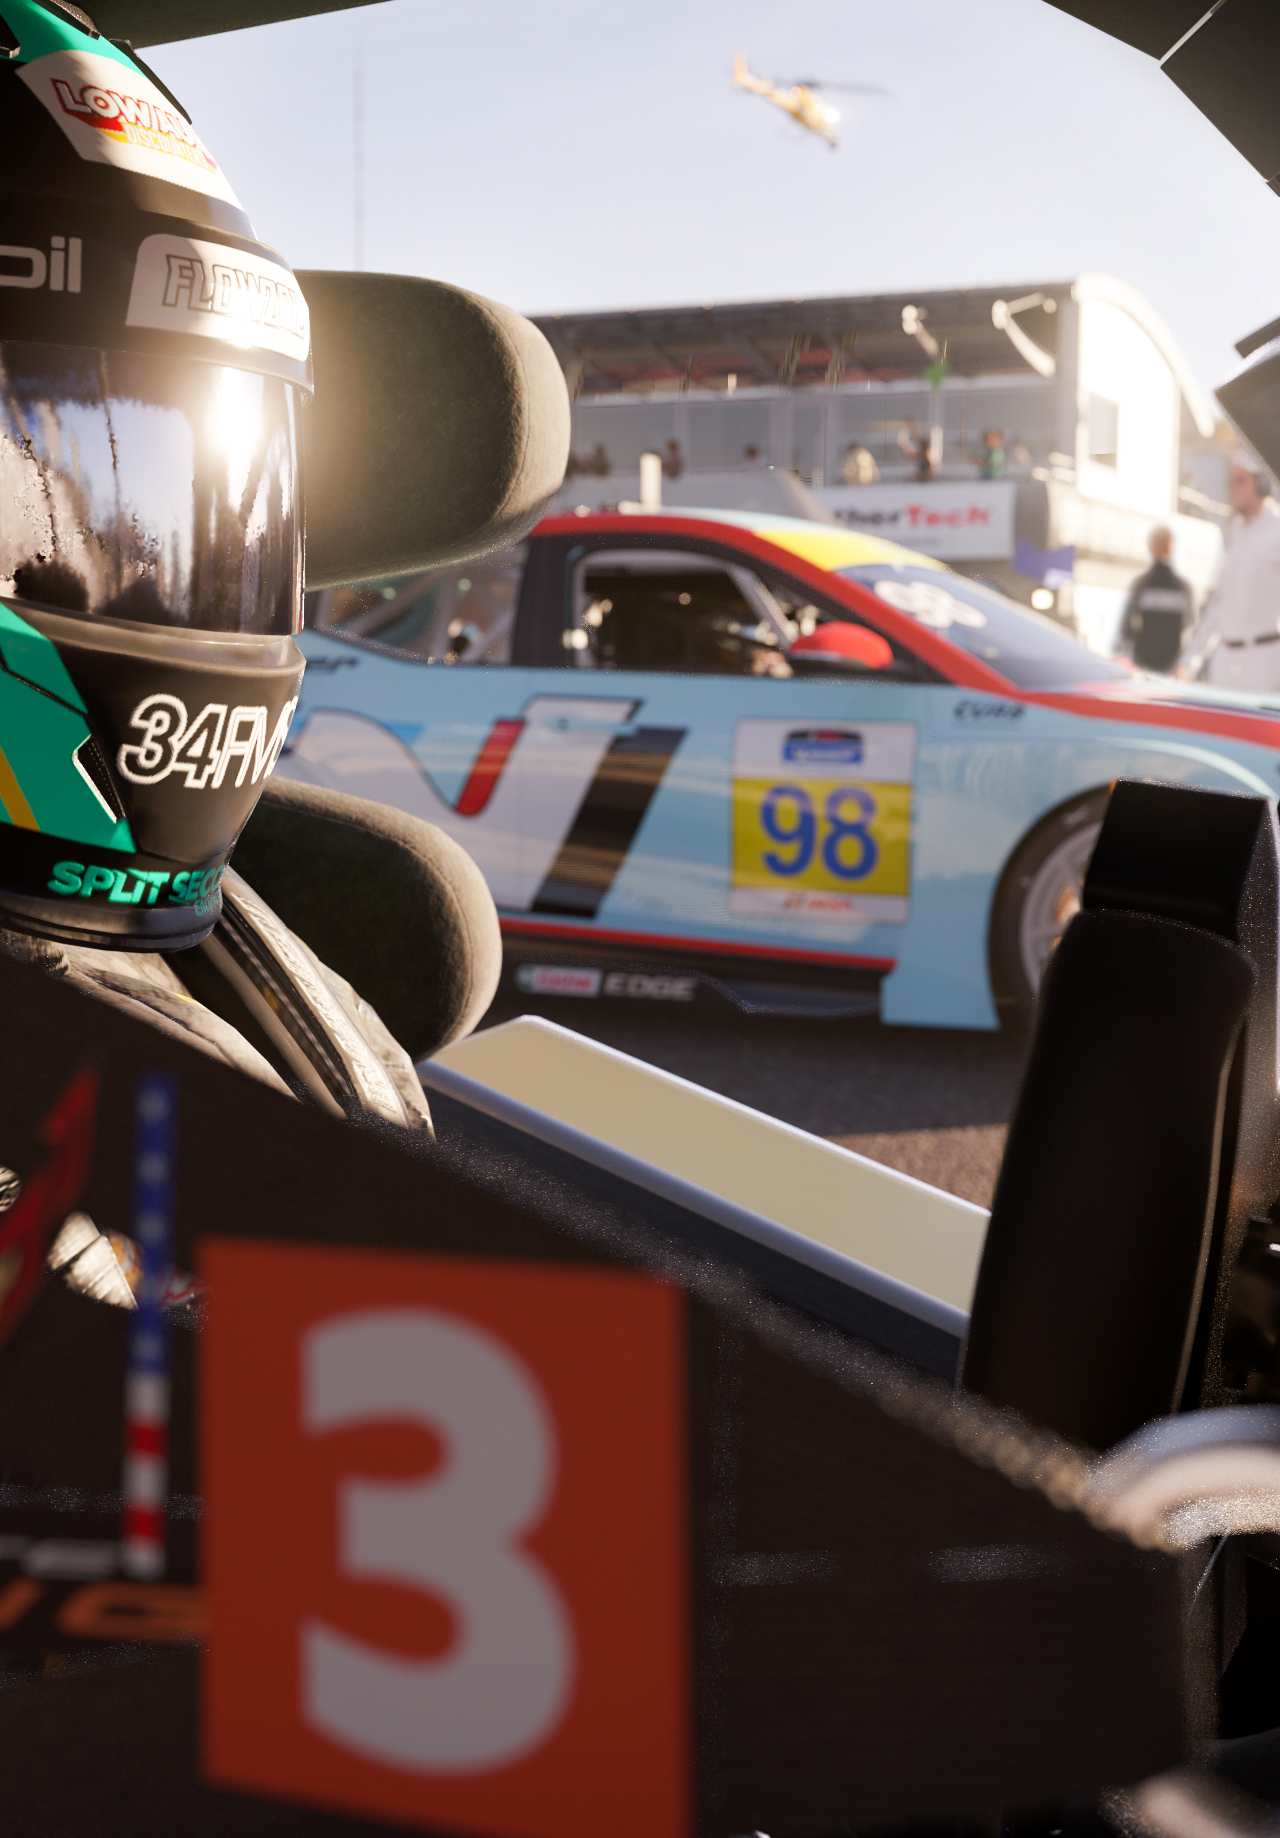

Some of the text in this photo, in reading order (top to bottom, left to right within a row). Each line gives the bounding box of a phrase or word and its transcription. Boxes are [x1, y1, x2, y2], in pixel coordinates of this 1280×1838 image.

[758, 784, 878, 881] 98
[47, 860, 170, 905] SPLIT
[299, 1303, 579, 1780] 3
